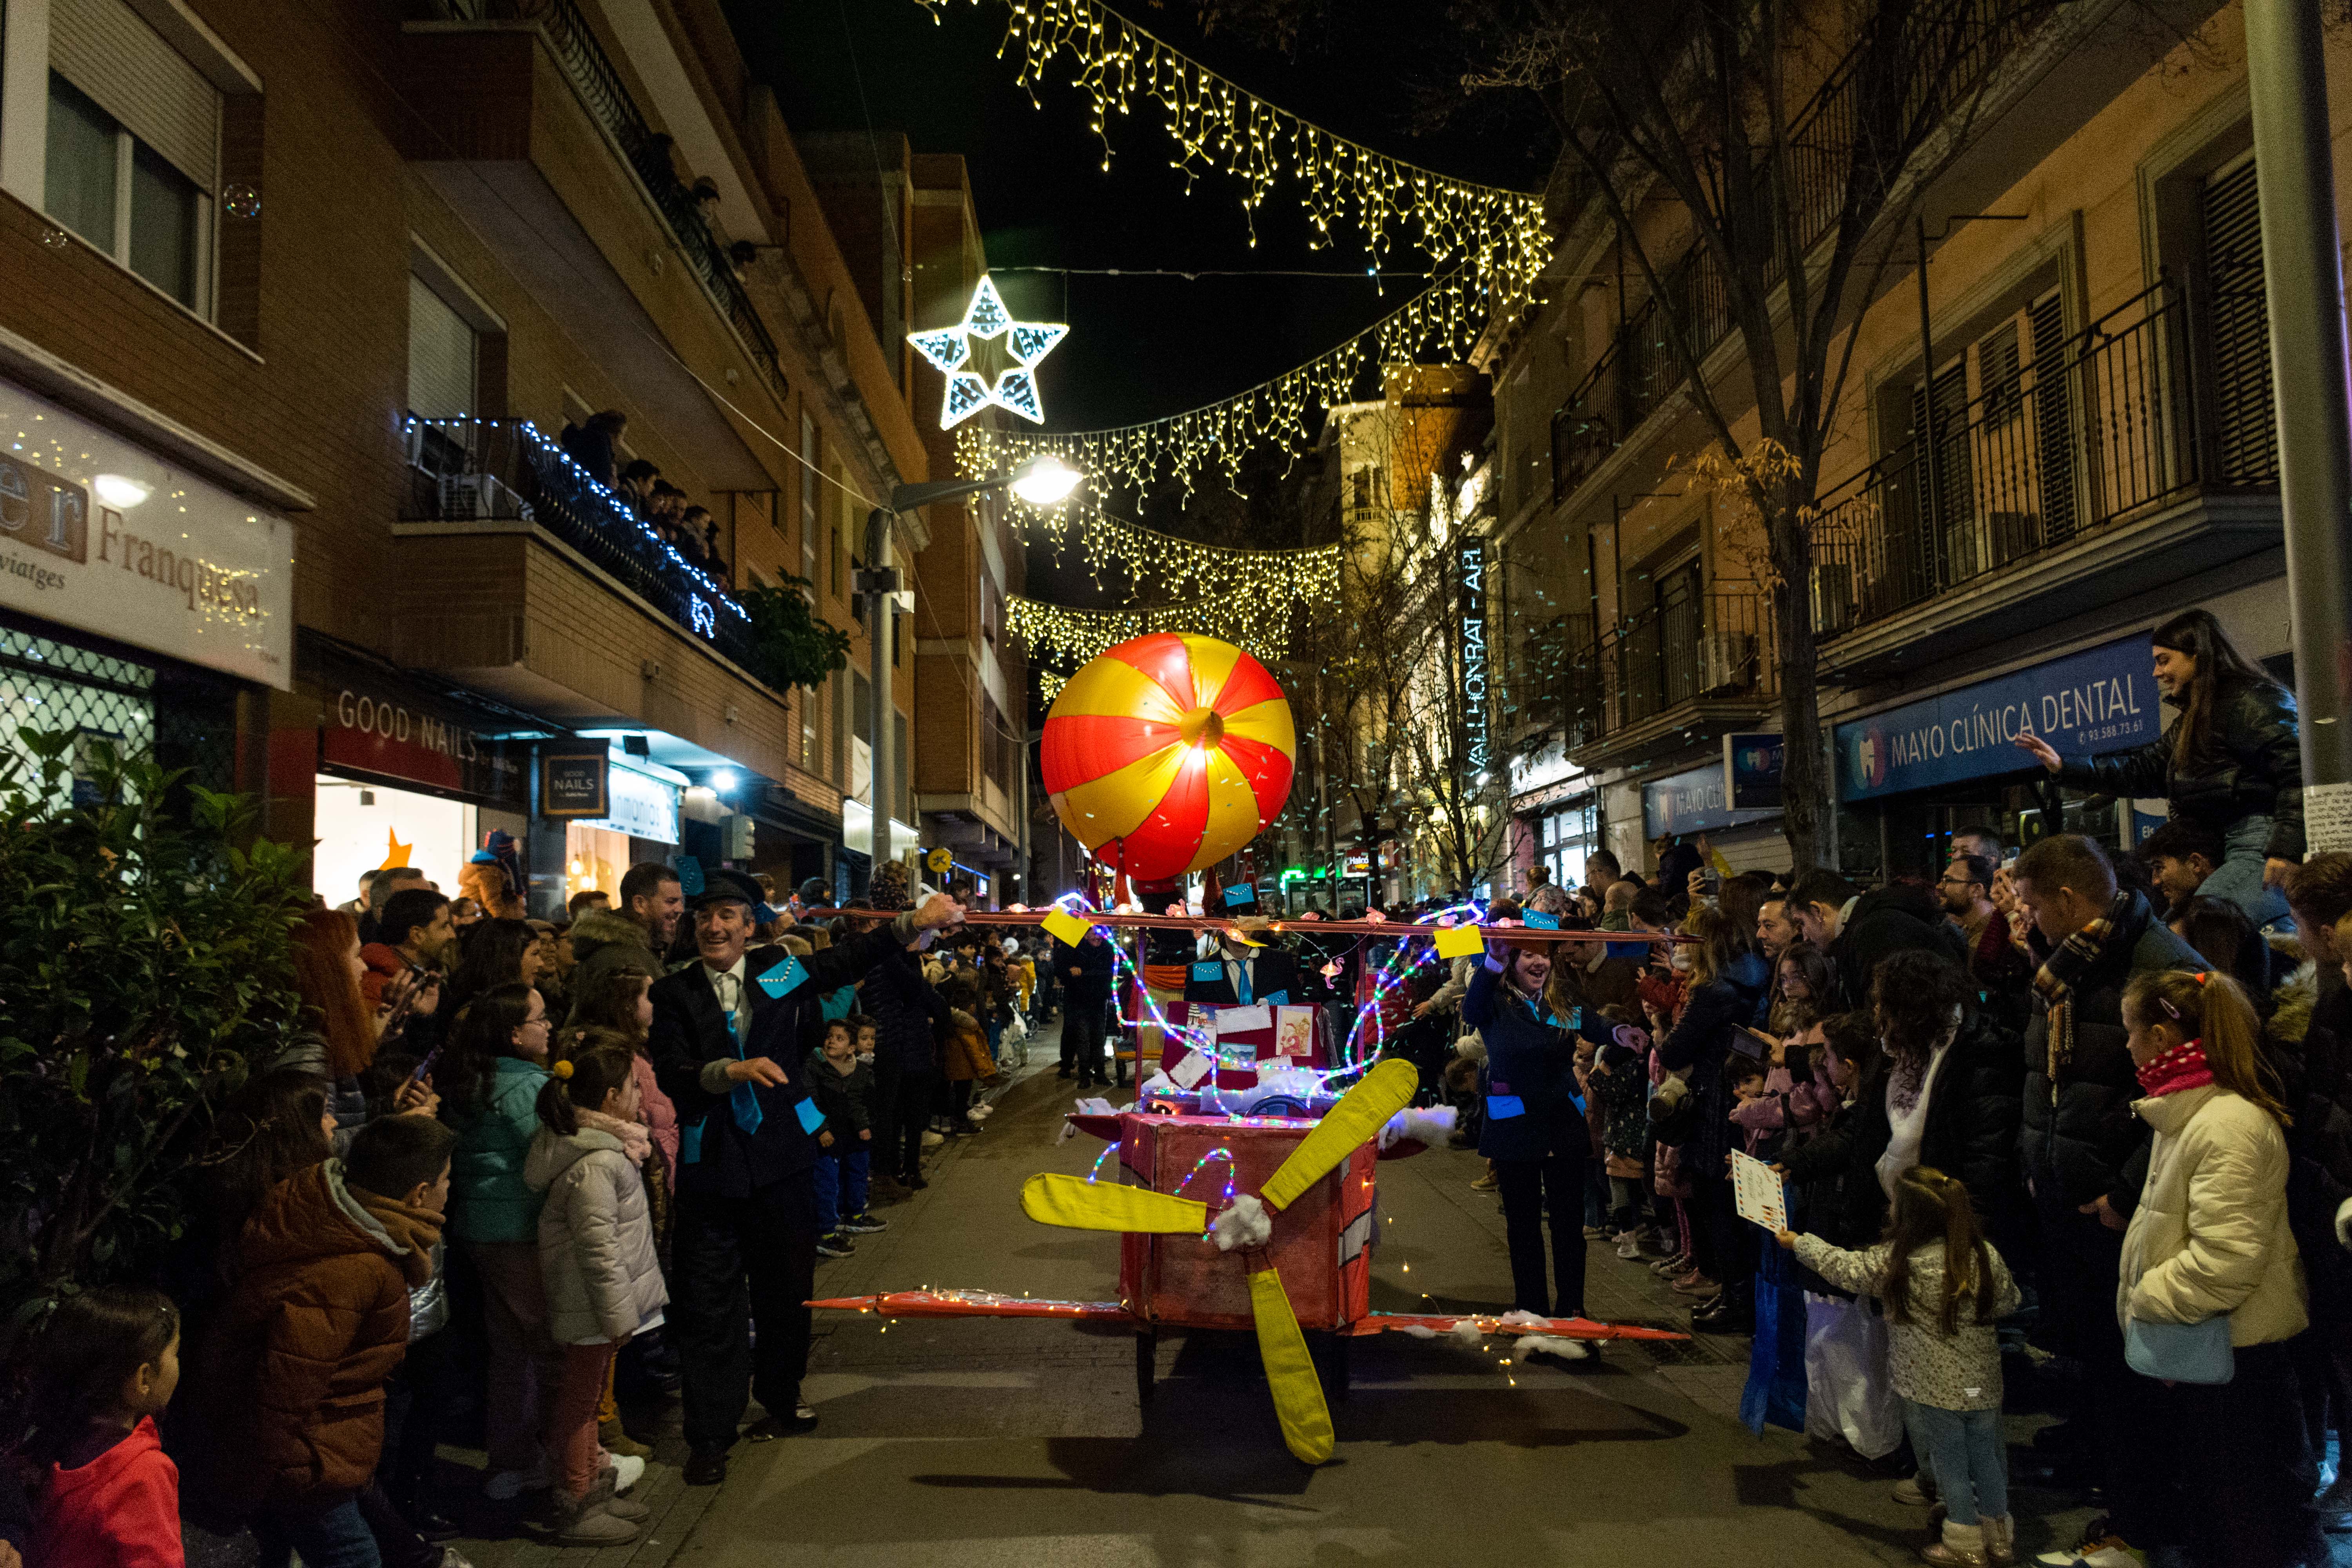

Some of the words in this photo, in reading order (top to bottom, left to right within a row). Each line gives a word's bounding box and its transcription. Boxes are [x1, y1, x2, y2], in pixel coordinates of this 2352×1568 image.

[98, 505, 260, 617] Franquesa
[339, 690, 410, 742] GOOD
[421, 715, 477, 762] NAILS
[1464, 617, 1487, 777] VALLHONRAT
[1891, 725, 1944, 768] MAYO
[1951, 702, 2034, 754] CLÍNICA
[2042, 674, 2141, 733] DENTAL
[554, 779, 594, 790] NAILS
